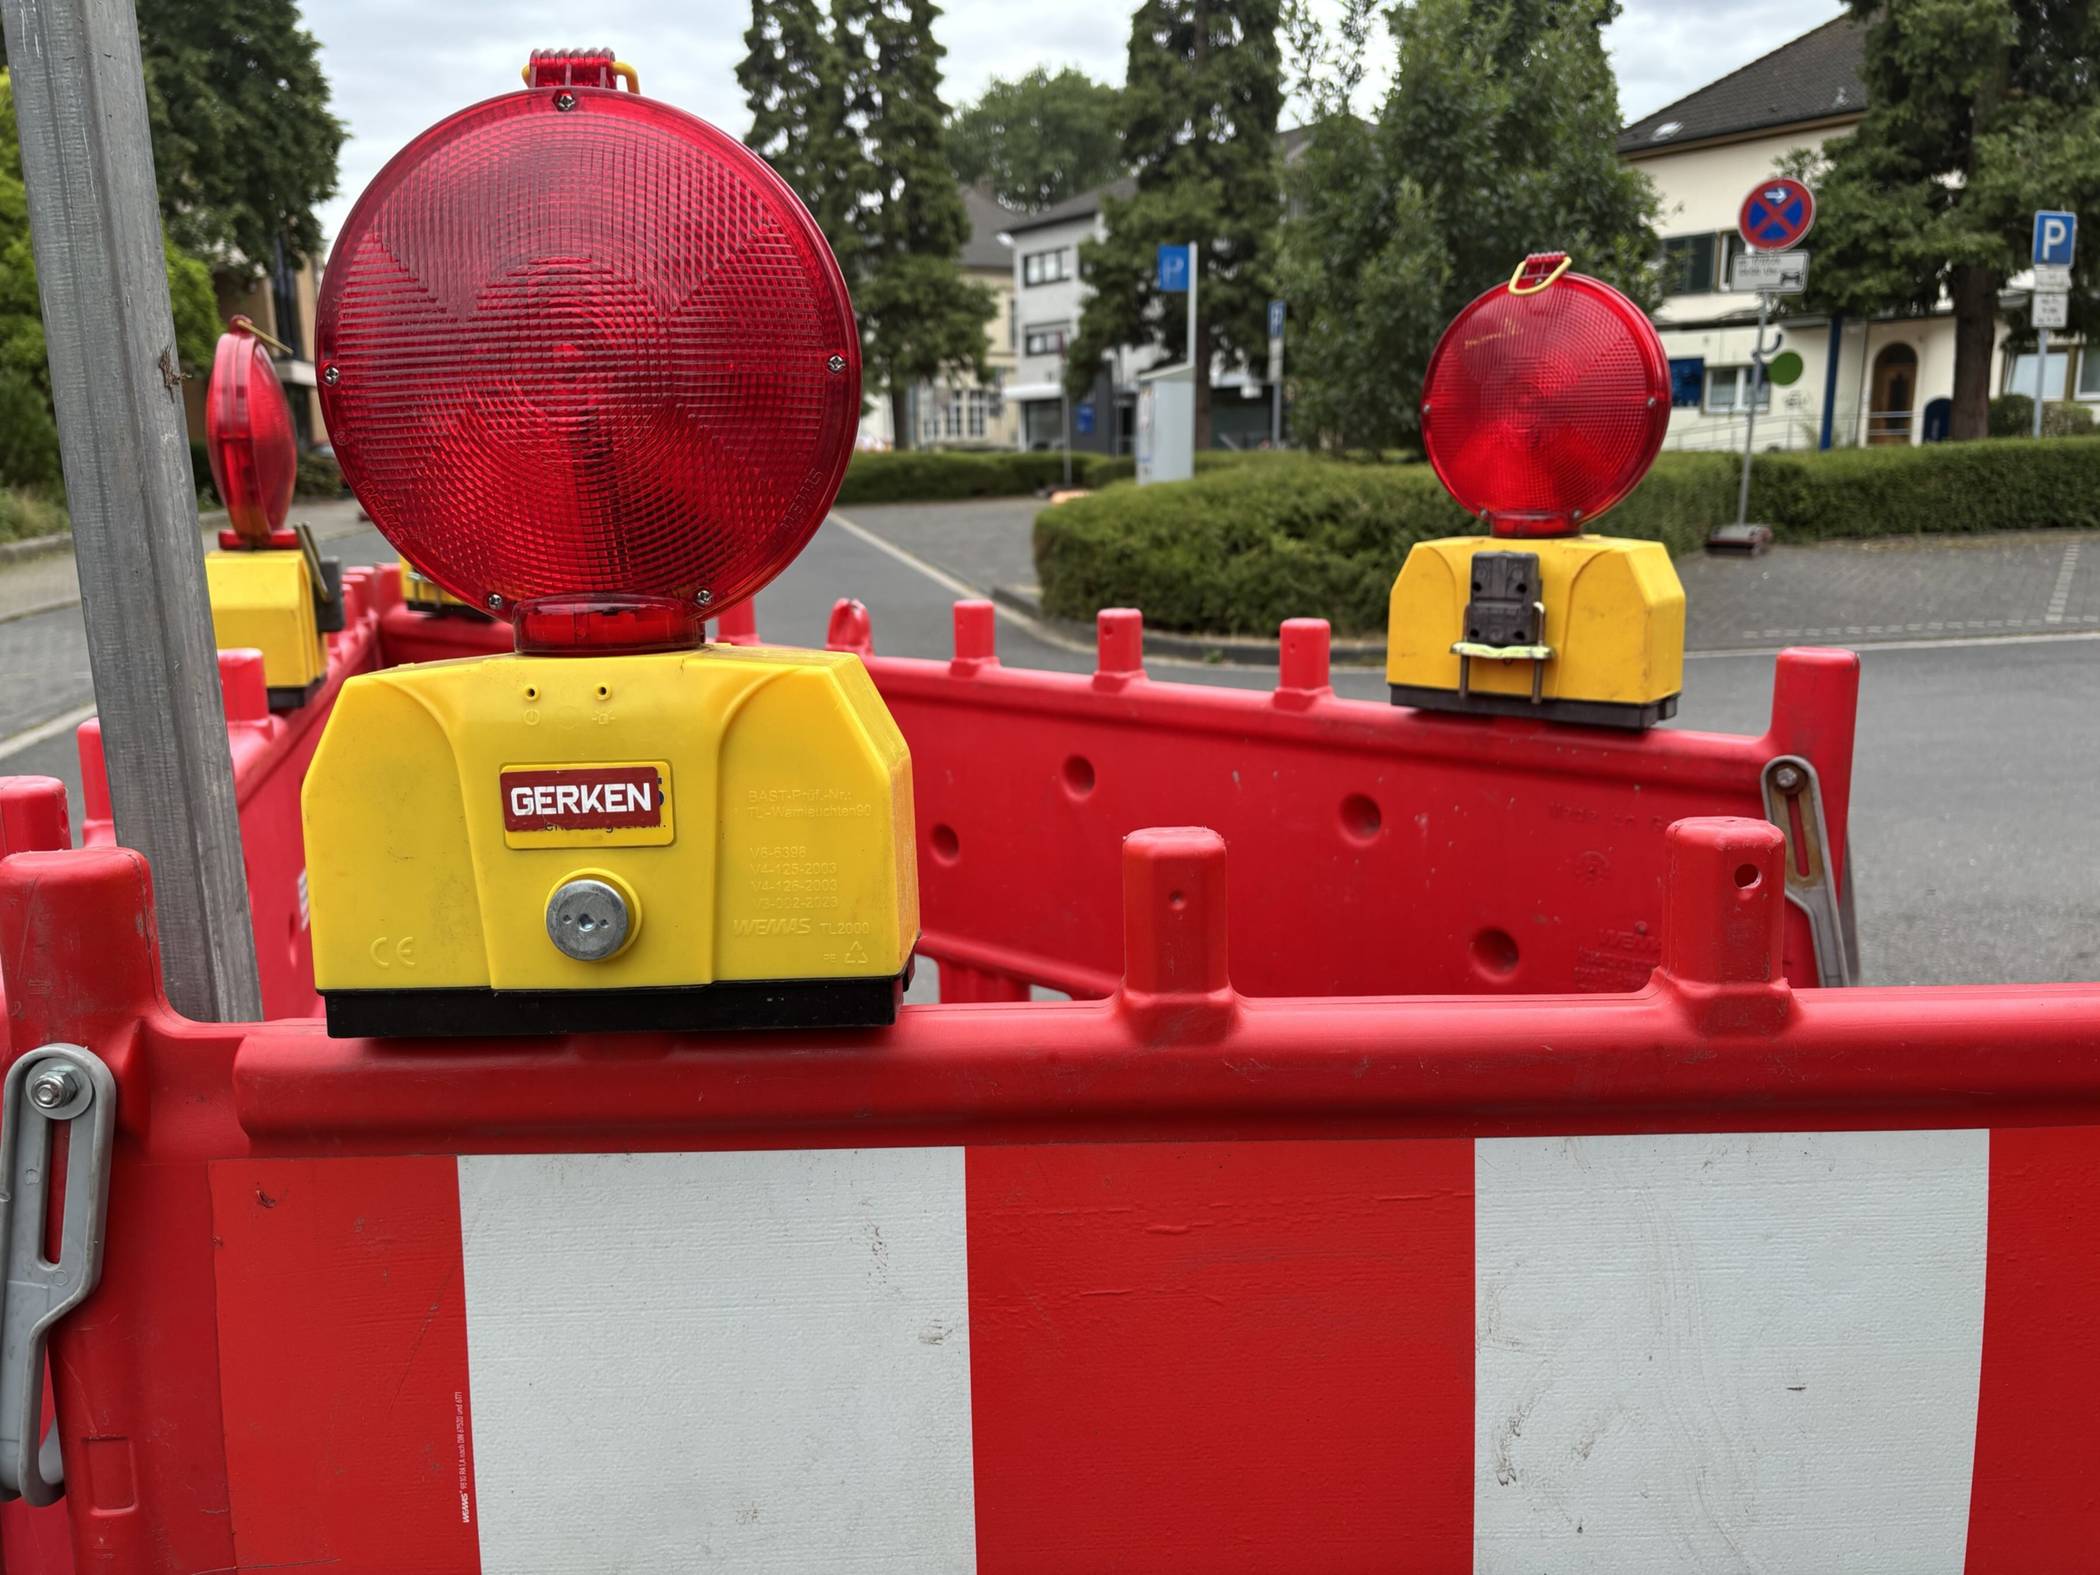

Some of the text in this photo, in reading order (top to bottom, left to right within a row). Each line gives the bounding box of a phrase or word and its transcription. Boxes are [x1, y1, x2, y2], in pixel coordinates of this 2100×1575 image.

[2043, 218, 2066, 260] P
[510, 783, 652, 817] GERKEN
[732, 917, 812, 937] WEMAS
[369, 935, 416, 968] CE
